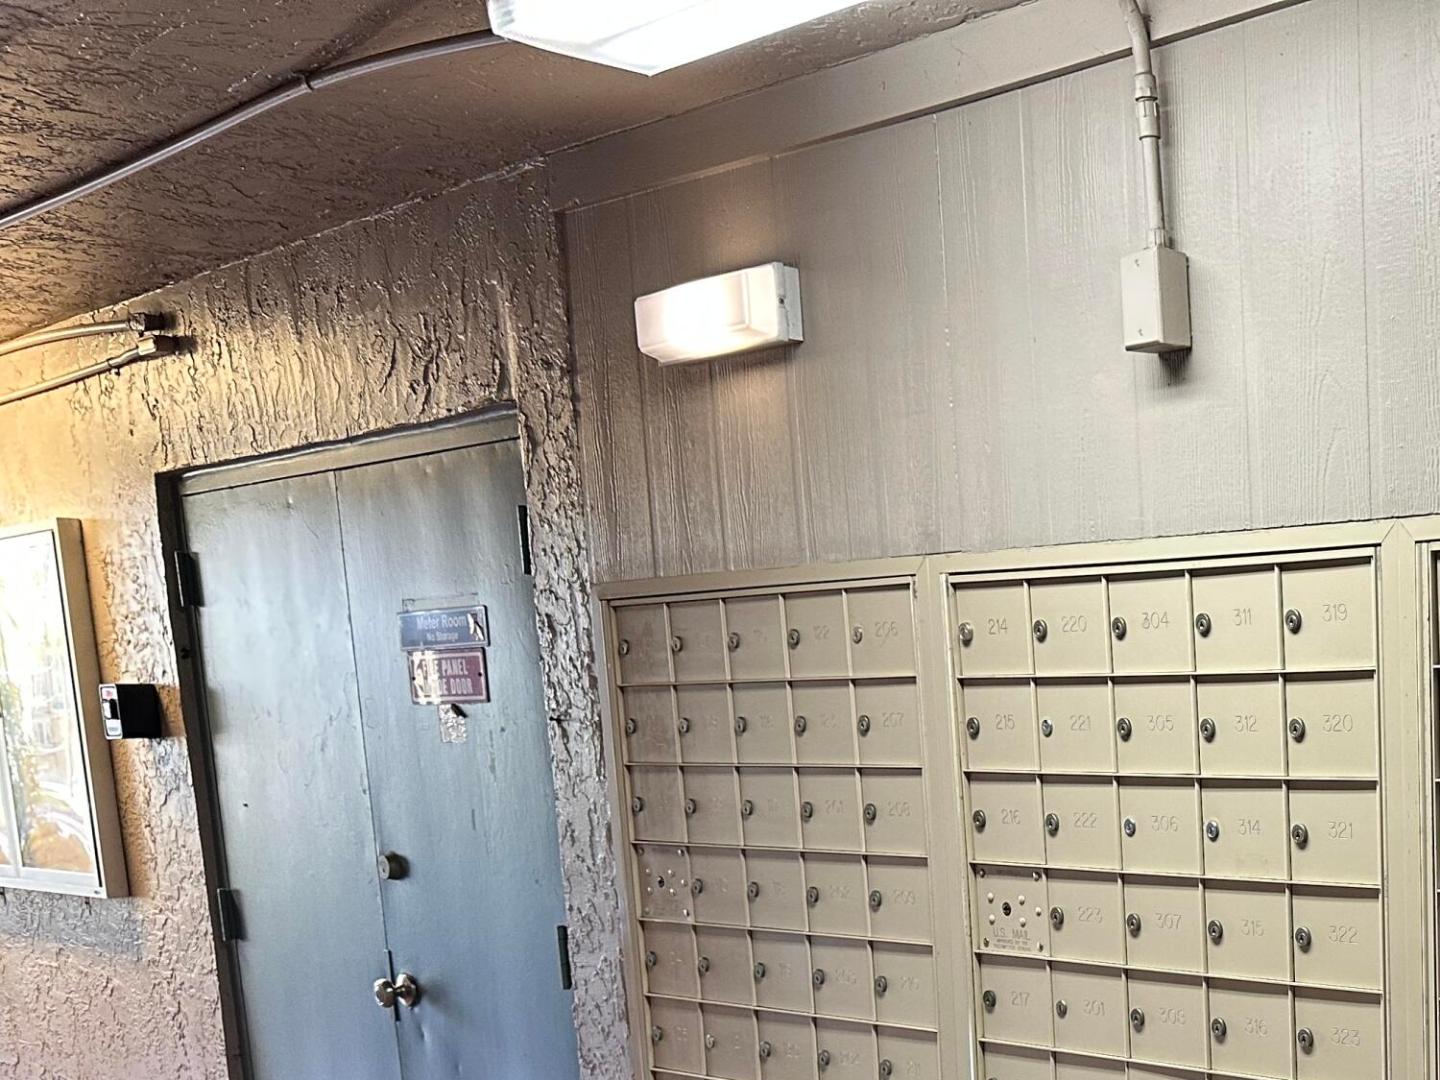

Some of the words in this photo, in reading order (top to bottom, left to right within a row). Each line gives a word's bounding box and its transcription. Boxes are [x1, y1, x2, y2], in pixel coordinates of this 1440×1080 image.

[442, 614, 466, 627] Room
[1141, 611, 1170, 629] 304
[1232, 608, 1252, 627] 311
[1322, 602, 1348, 623] 319
[988, 619, 1008, 636] 214
[1061, 615, 1087, 634] 220
[442, 658, 468, 676] PANEL
[450, 678, 473, 695] DOOR
[995, 714, 1015, 731] 215
[1070, 714, 1091, 732] 221
[1146, 714, 1175, 732] 305
[1233, 714, 1258, 733] 312
[1322, 713, 1354, 733] 320
[1001, 809, 1021, 826] 216
[1073, 812, 1097, 829] 222
[1150, 815, 1179, 833] 306
[1237, 819, 1261, 836] 314
[1328, 821, 1353, 840] 321
[1154, 912, 1182, 931] 307
[1241, 919, 1264, 937] 315
[1328, 925, 1359, 944] 322
[1010, 991, 1030, 1007] 217
[1082, 999, 1105, 1017] 301
[1244, 1017, 1269, 1038] 316
[1330, 1027, 1361, 1047] 323
